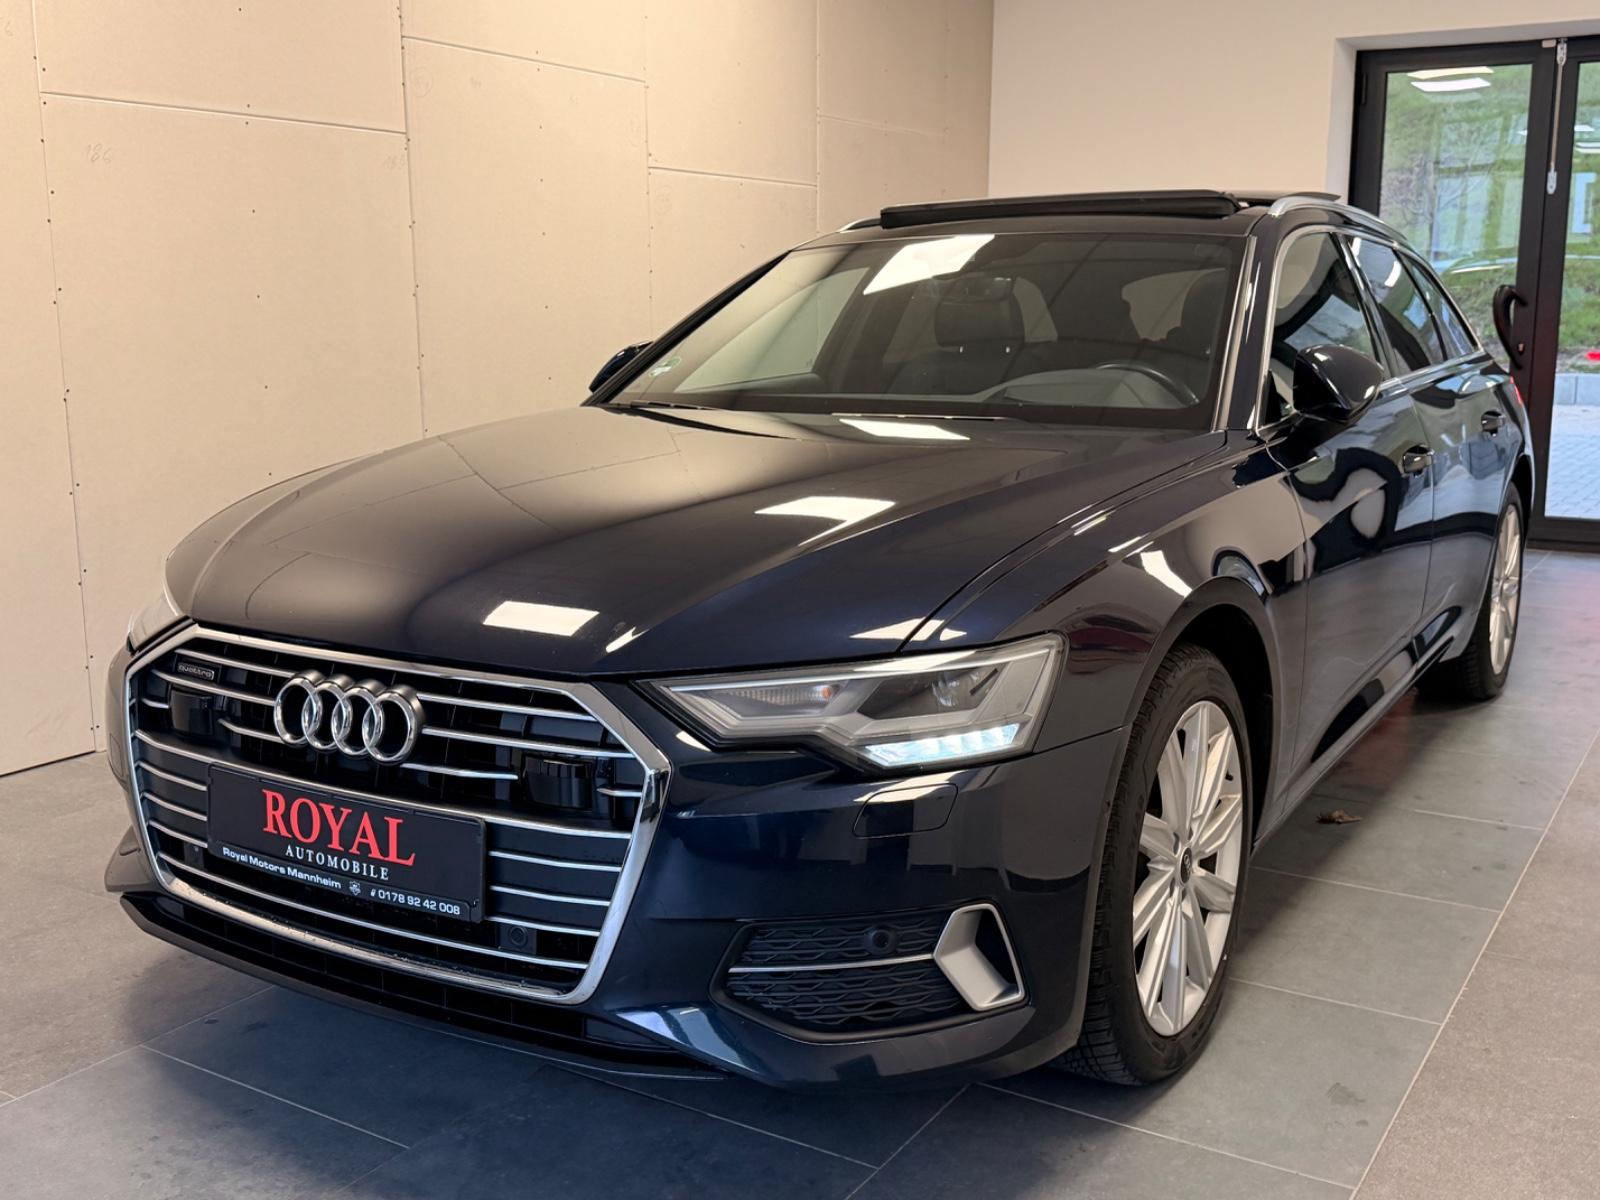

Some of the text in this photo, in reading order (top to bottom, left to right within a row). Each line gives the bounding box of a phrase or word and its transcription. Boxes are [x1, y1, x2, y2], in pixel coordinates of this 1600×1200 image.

[262, 788, 416, 866] ROYAL
[222, 846, 342, 889] Royal Motors Mannheim
[285, 844, 389, 881] AUTOMOBILE
[378, 889, 461, 915] 0178 92 42 008
